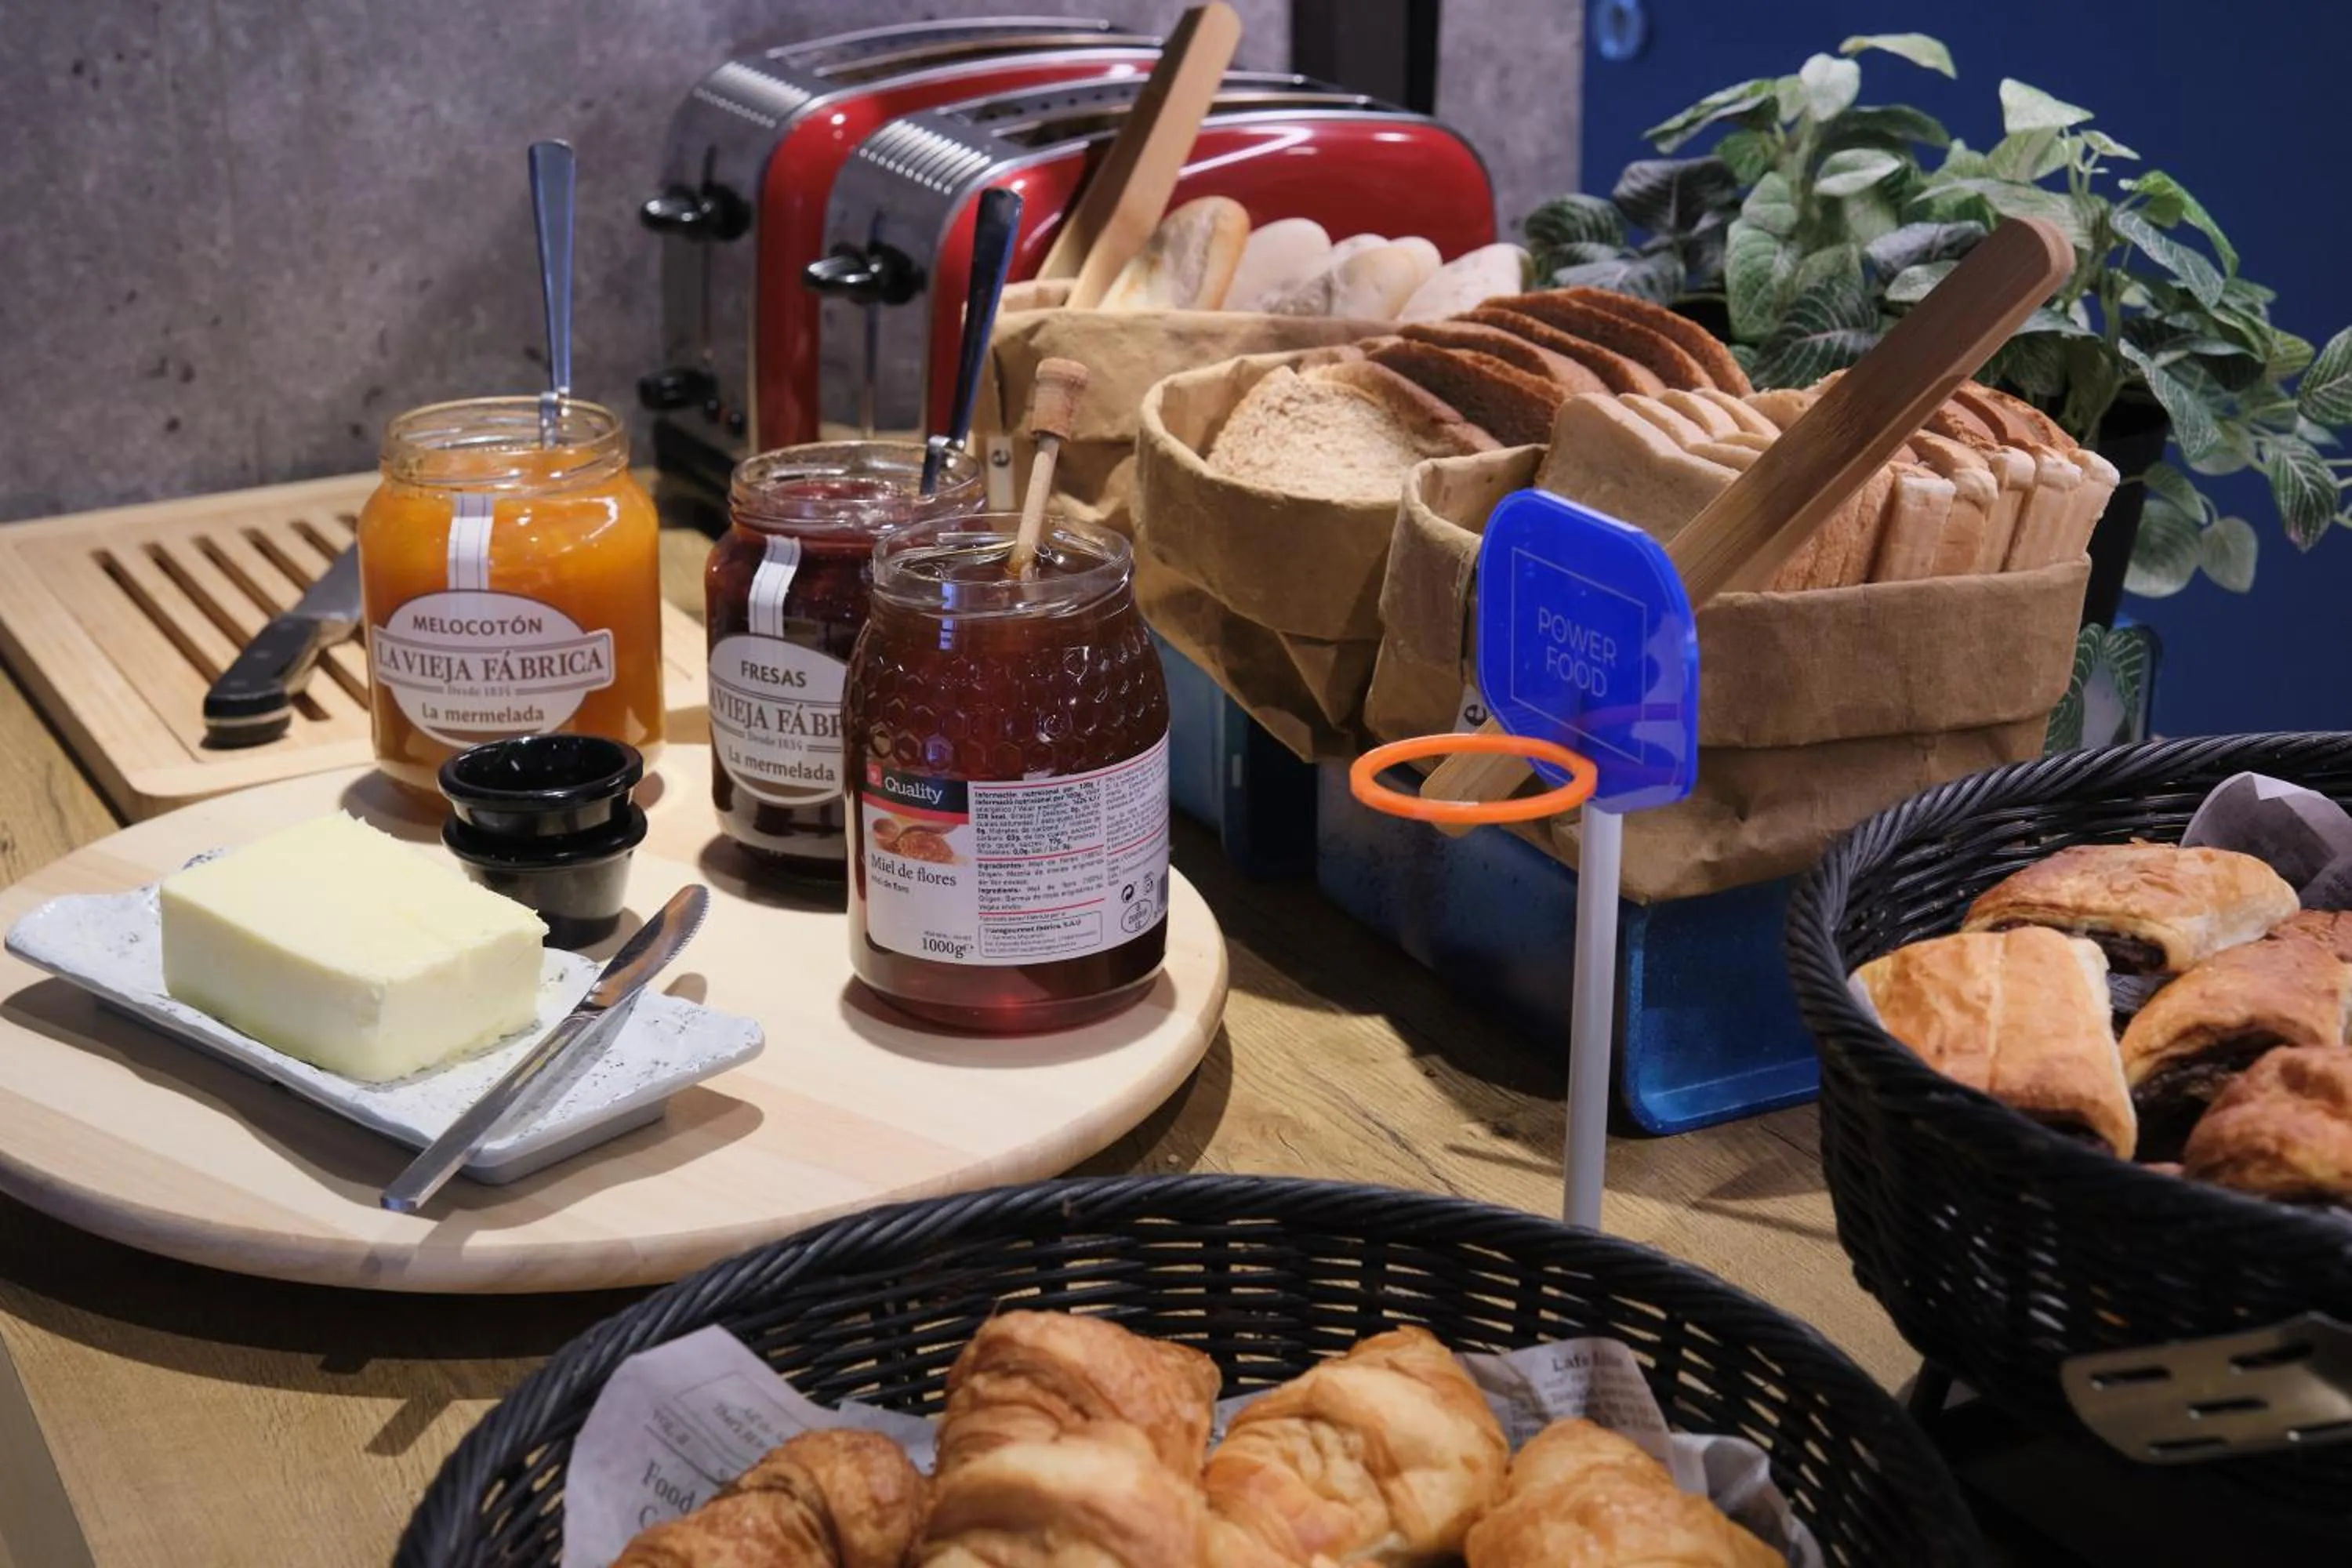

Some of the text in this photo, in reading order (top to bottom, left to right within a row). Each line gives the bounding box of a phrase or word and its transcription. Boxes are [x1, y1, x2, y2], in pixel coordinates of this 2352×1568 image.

[412, 614, 543, 636] MELOCOTÓN
[1537, 606, 1617, 668] POWER
[480, 646, 604, 682] FÁBRICA
[740, 660, 807, 688] FRESAS
[1546, 645, 1608, 698] FOOD
[447, 685, 481, 697] Desde
[421, 702, 545, 724] La mermelada
[728, 746, 836, 782] La mermelada
[884, 775, 943, 805] Quality
[871, 853, 957, 887] Miel de flores
[639, 1459, 697, 1514] Food
